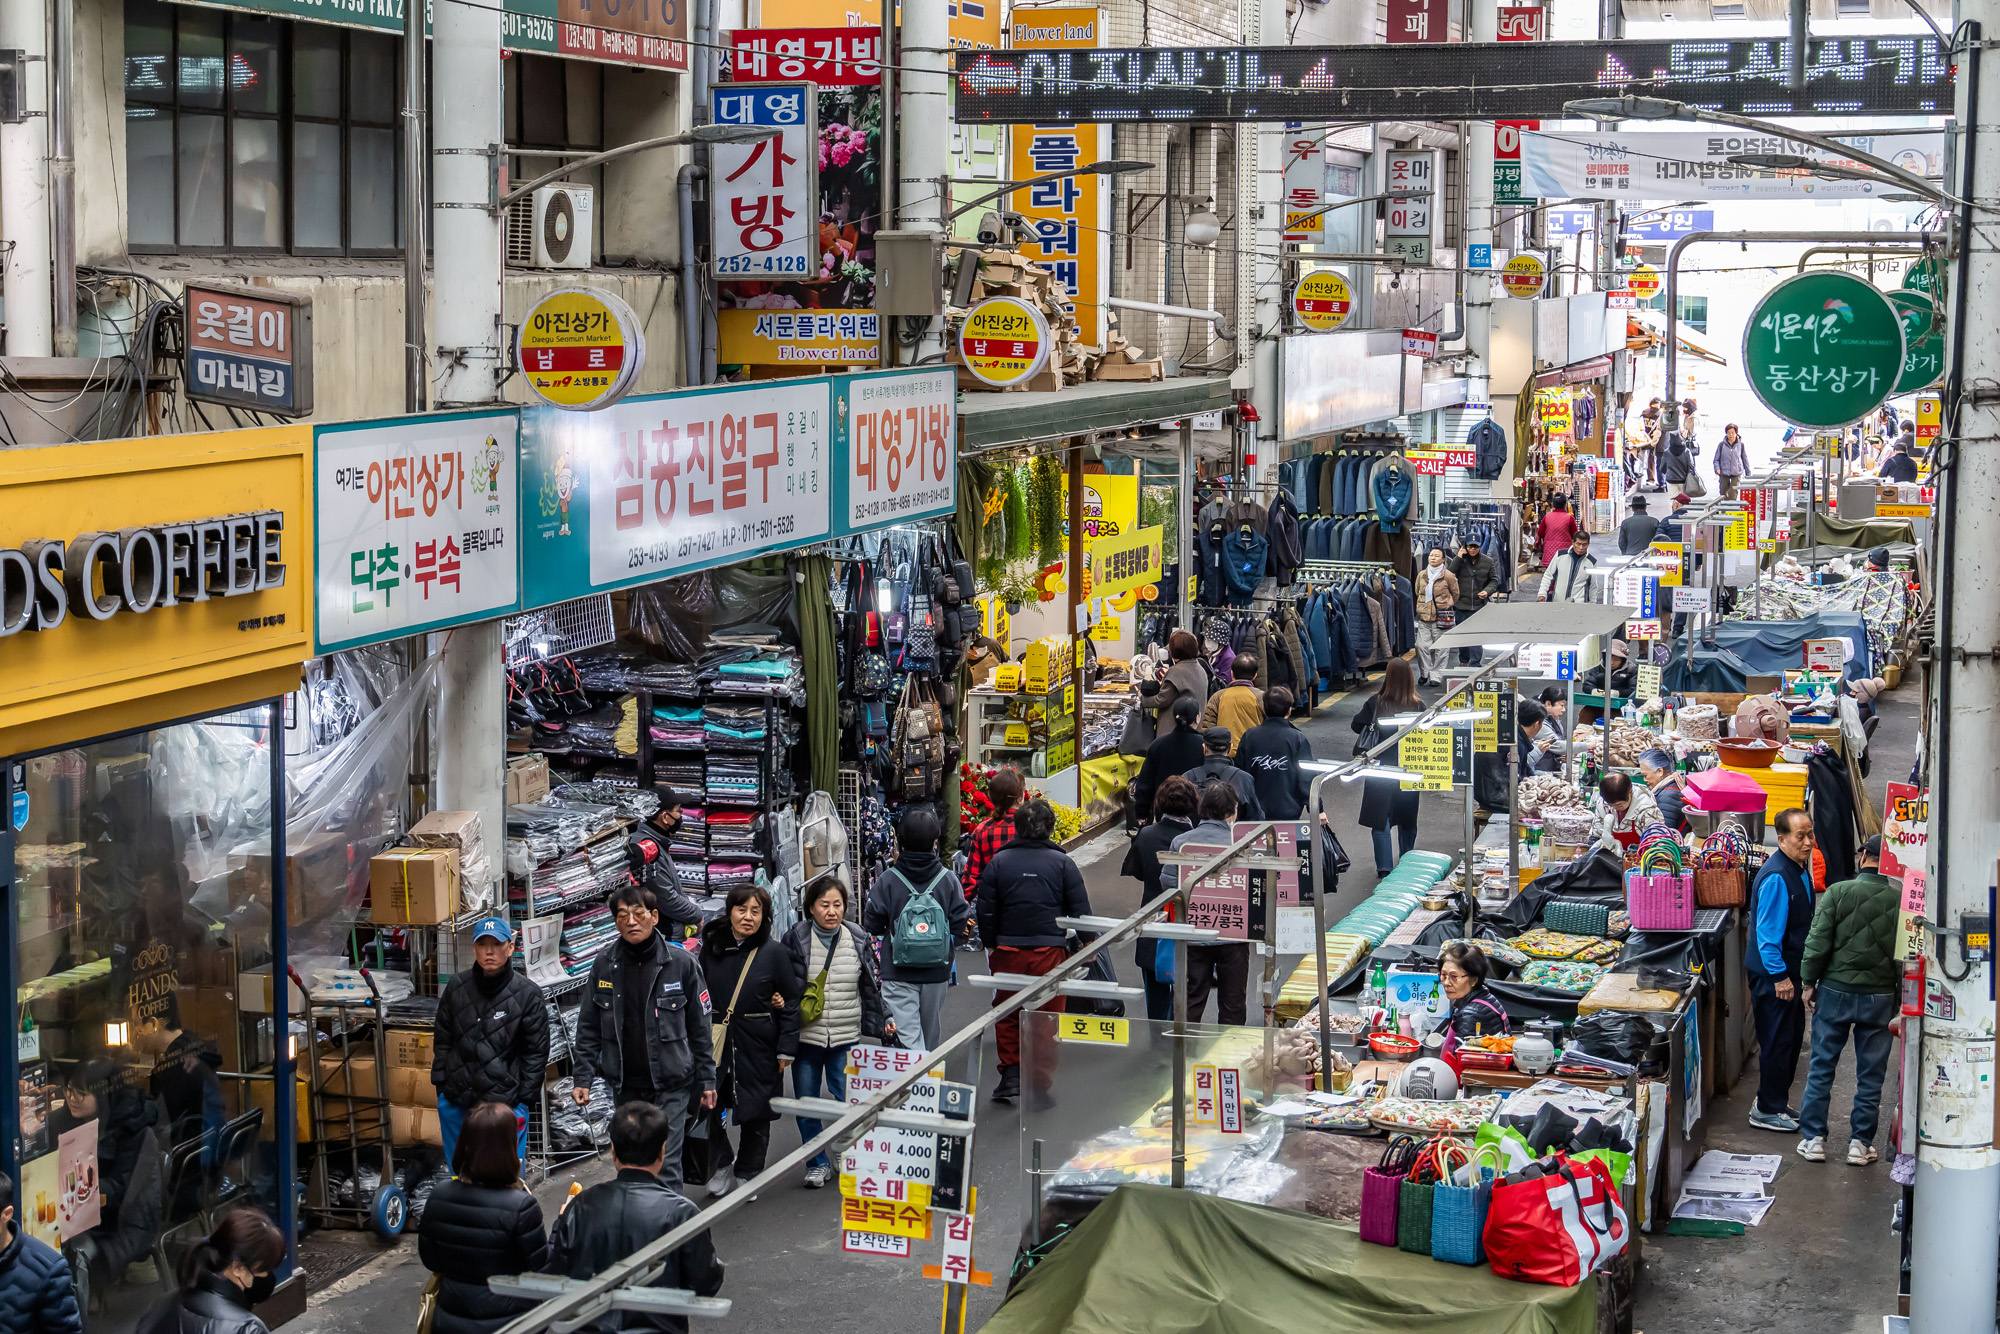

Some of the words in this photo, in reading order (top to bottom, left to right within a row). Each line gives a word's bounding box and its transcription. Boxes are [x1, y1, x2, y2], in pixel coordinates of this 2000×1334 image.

[1014, 23, 1062, 41] Flower
[1064, 21, 1094, 40] land
[1497, 9, 1542, 42] try
[737, 37, 881, 78] 대영가방
[719, 94, 800, 124] 대영
[579, 196, 589, 210] LG
[724, 135, 798, 252] 가방
[1473, 248, 1487, 258] 2F
[718, 256, 807, 273] 252-4128
[1508, 261, 1540, 272] 아진상가
[1303, 281, 1344, 295] 아진상가
[196, 300, 285, 352] 옷걸이
[533, 311, 610, 334] 아진상가
[972, 314, 1029, 332] 아진상가
[1760, 311, 1842, 355] 서문시장
[531, 335, 555, 344] Daegu
[555, 334, 585, 343] Seomun
[586, 334, 612, 343] Market
[970, 330, 988, 338] Daegu
[988, 330, 1010, 338] Seomun
[537, 349, 555, 370] 남
[588, 348, 607, 368] 로
[778, 346, 838, 361] Flower
[842, 346, 879, 361] land
[974, 340, 988, 355] 남
[1011, 342, 1025, 356] 로
[999, 361, 1026, 370] 소방통로
[197, 357, 286, 398] 마네킹
[573, 375, 609, 387] 소방통로
[1765, 364, 1881, 396] 동산상가
[1922, 402, 1932, 413] 3
[856, 403, 950, 494] 대영가방
[1448, 452, 1474, 465] SALE
[1420, 460, 1444, 474] SALE
[335, 466, 365, 492] 여기는
[366, 451, 465, 521] 아진상가
[786, 467, 819, 497] 마네킹
[855, 500, 880, 520] 252-4128
[462, 527, 504, 555] 골목입니다
[628, 542, 670, 569] 253-4793
[677, 530, 716, 558] 257-7427
[741, 514, 795, 544] 011-501-5526
[70, 510, 287, 622] COFFEE
[1627, 624, 1660, 640] 감주
[1455, 735, 1463, 758] 먹거리
[1300, 848, 1310, 877] 먹거리
[1252, 877, 1261, 907] 먹거리
[1189, 901, 1244, 915] 속이시원한
[1187, 913, 1245, 930] 감주/콩국
[128, 969, 179, 1008] HANDS
[1411, 991, 1428, 1001] 이슬
[137, 996, 170, 1019] COFFEE
[1071, 1019, 1116, 1041] 호떡
[950, 1092, 957, 1102] 3
[1196, 1071, 1213, 1116] 감주
[1223, 1072, 1237, 1129] 납작만두
[896, 1144, 932, 1160] 4,000
[940, 1136, 953, 1164] 거리
[894, 1164, 931, 1179] 4,000
[859, 1176, 905, 1201] 순대
[844, 1197, 923, 1229] 칼국수
[848, 1231, 905, 1252] 납작만두
[944, 1215, 972, 1280] 감주
